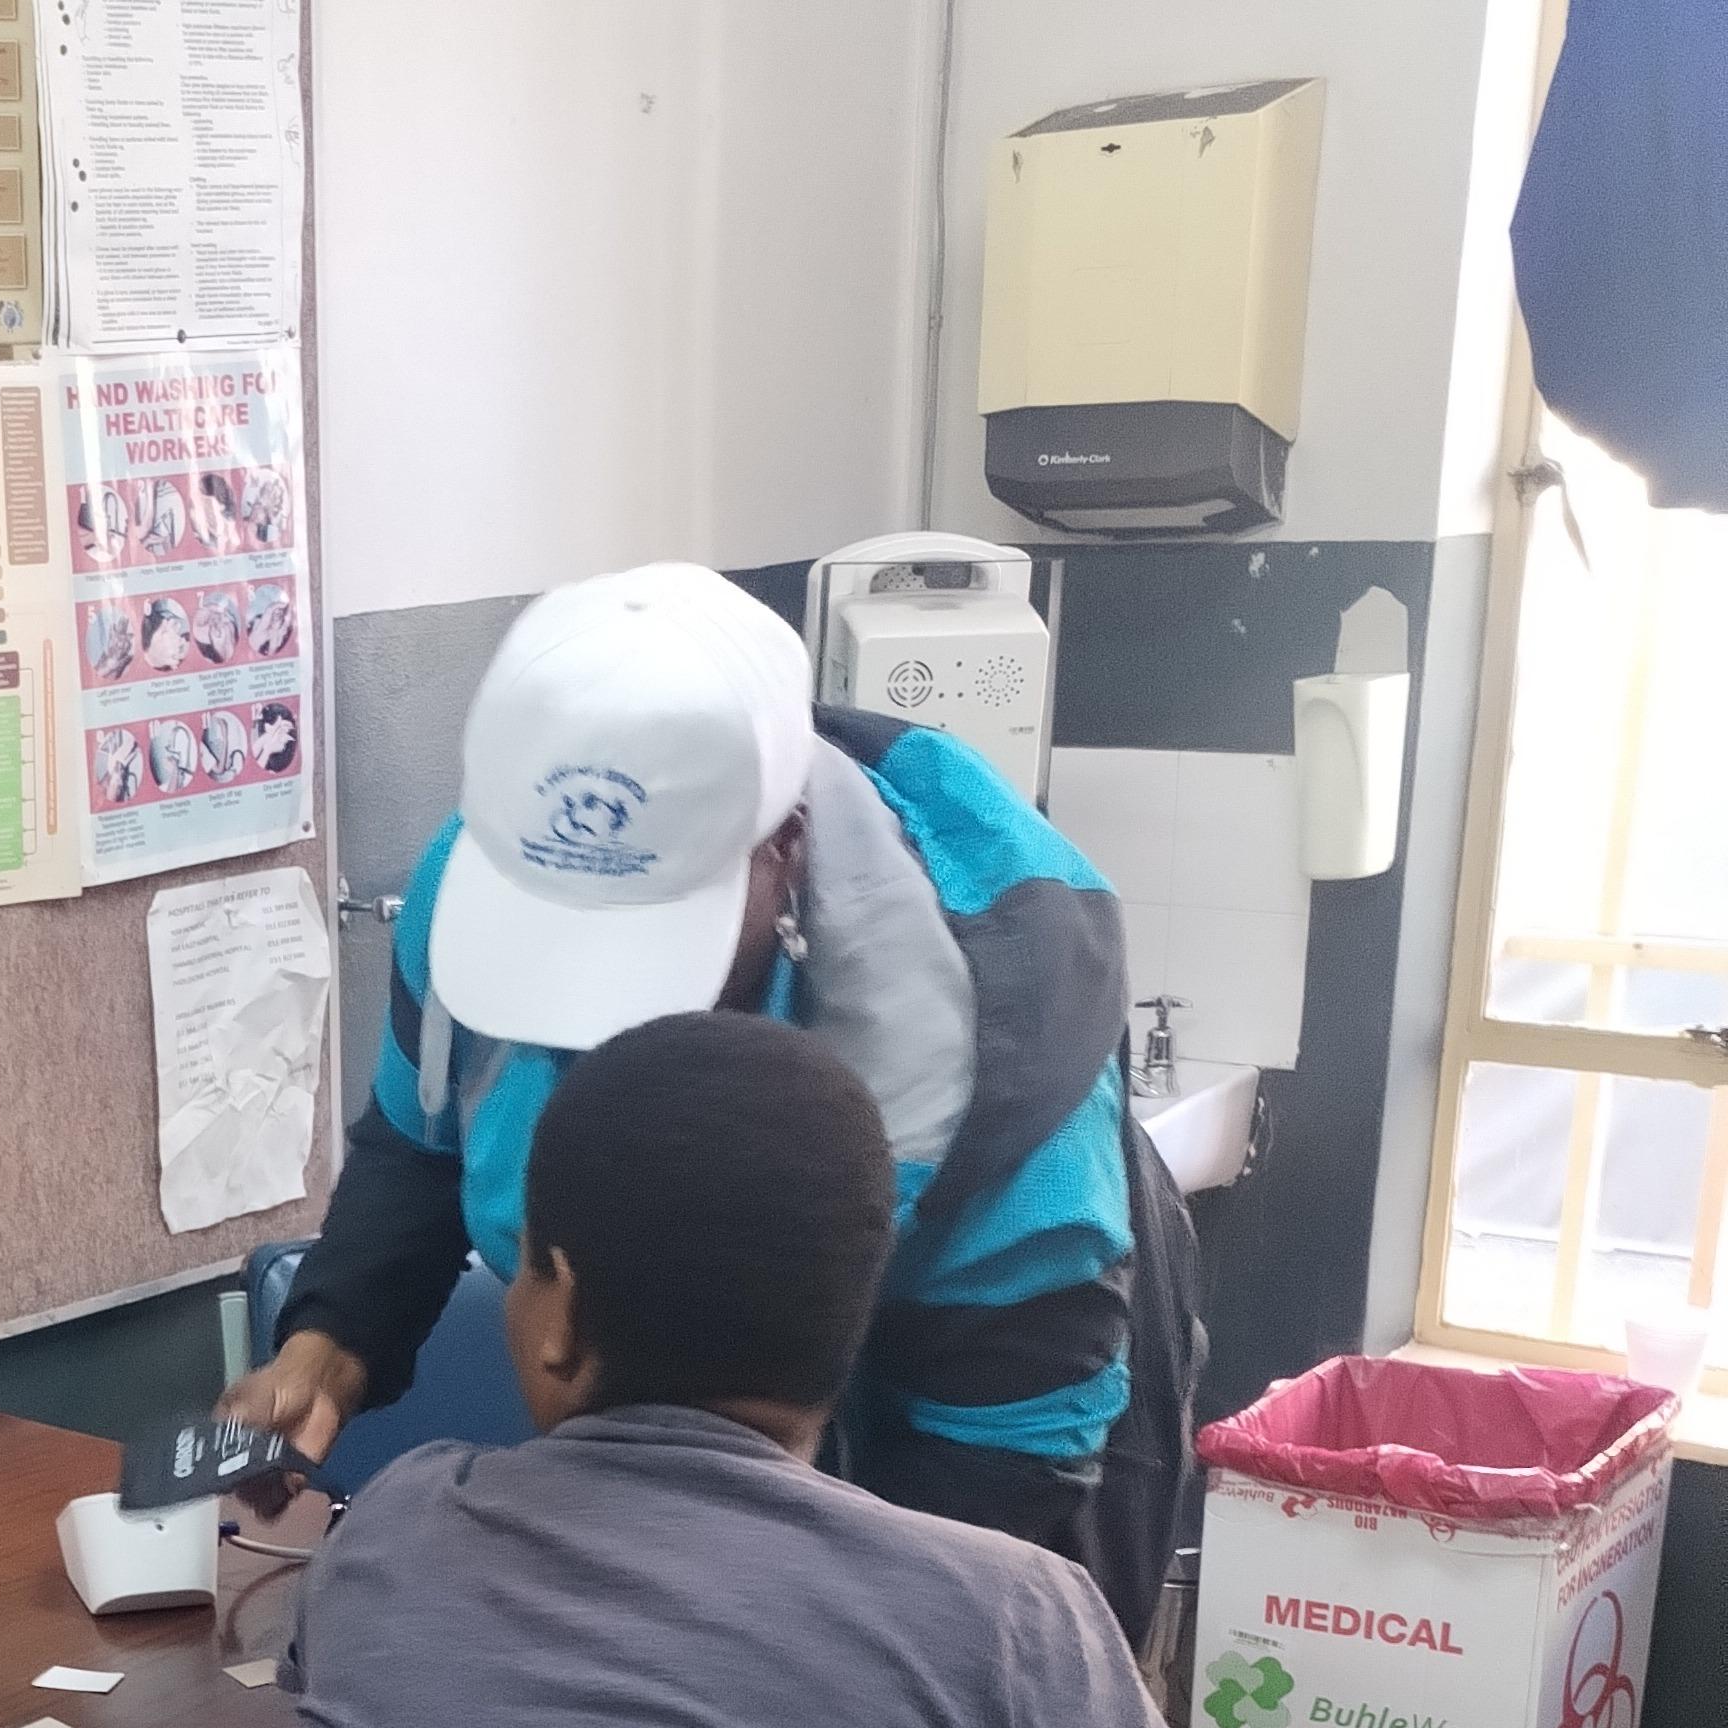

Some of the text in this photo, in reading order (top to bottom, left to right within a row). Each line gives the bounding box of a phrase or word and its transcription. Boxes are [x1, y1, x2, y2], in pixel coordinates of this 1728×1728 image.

[66, 381, 129, 410] HND
[87, 605, 97, 623] 5
[1354, 1515, 1378, 1531] BIO
[1264, 1594, 1463, 1655] MEDICAL
